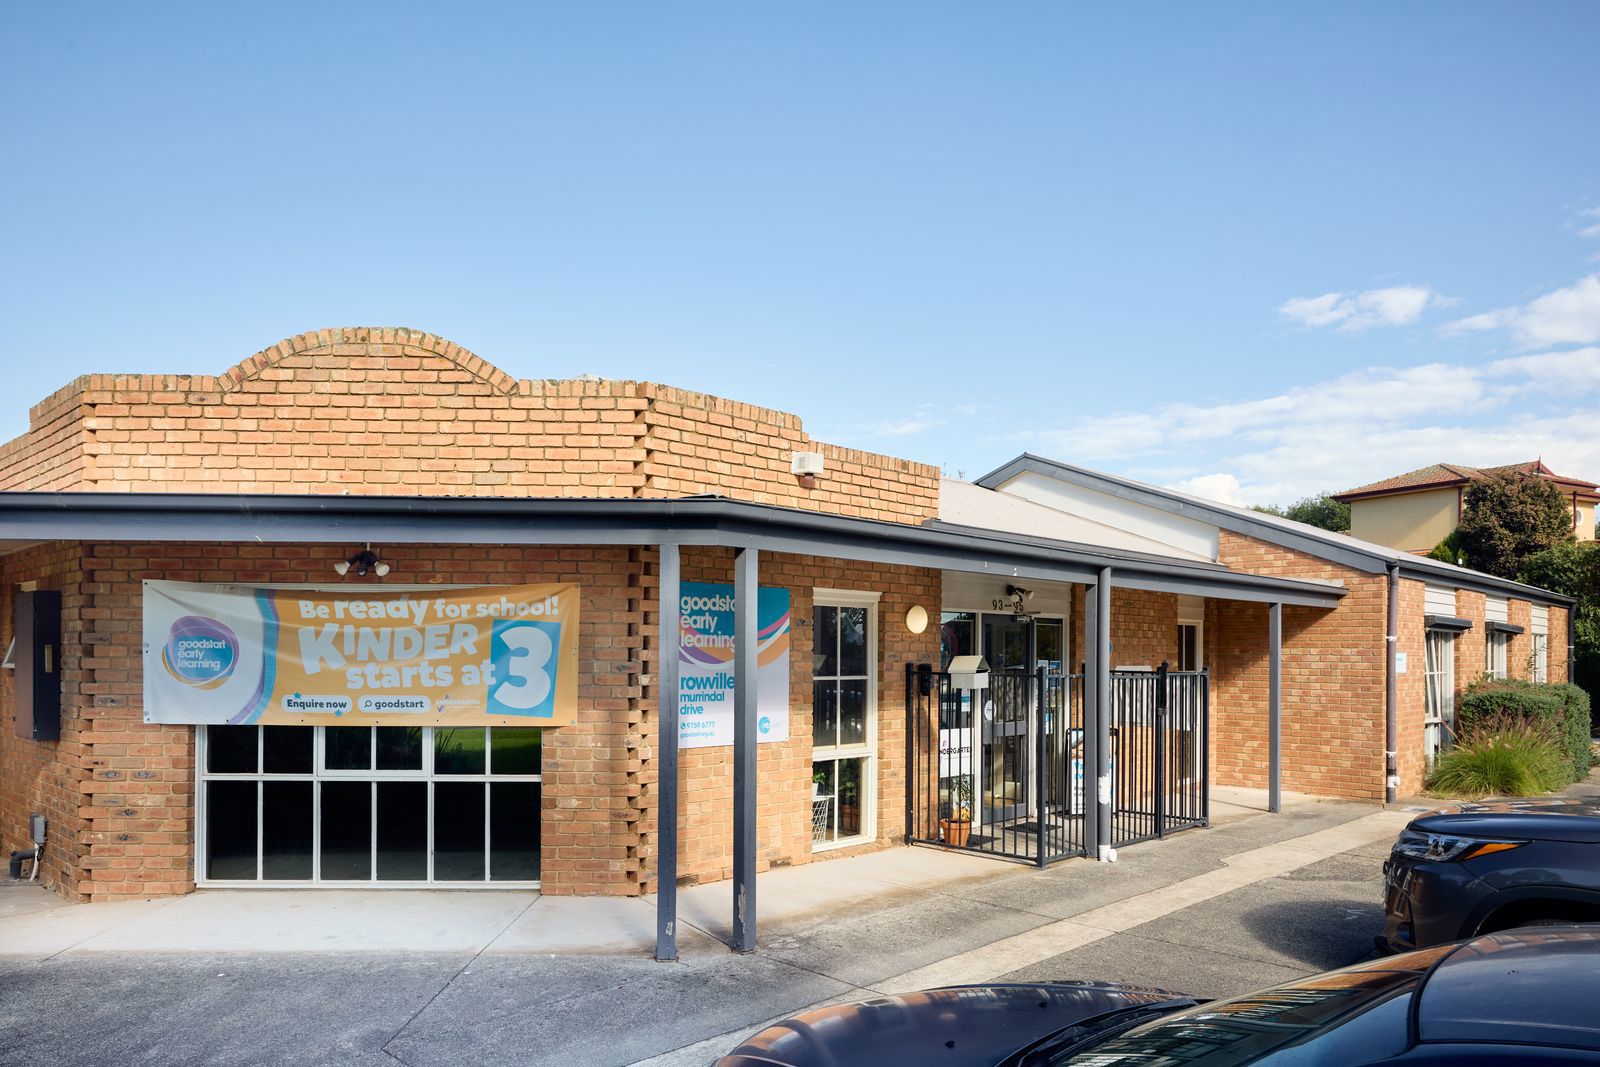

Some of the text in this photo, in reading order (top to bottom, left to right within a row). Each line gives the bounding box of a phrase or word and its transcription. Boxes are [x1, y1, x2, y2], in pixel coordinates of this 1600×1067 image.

[299, 594, 559, 626] Be ready for school!
[680, 612, 718, 634] early
[178, 639, 226, 650] goodstart
[298, 623, 478, 675] KINDER
[177, 649, 204, 661] early
[177, 659, 220, 671] learning
[346, 626, 553, 709] starts at 3
[680, 672, 735, 690] rowville
[680, 690, 725, 702] murrindal
[287, 699, 325, 710] Enquire
[375, 699, 424, 710] goodstart
[680, 704, 704, 715] drive
